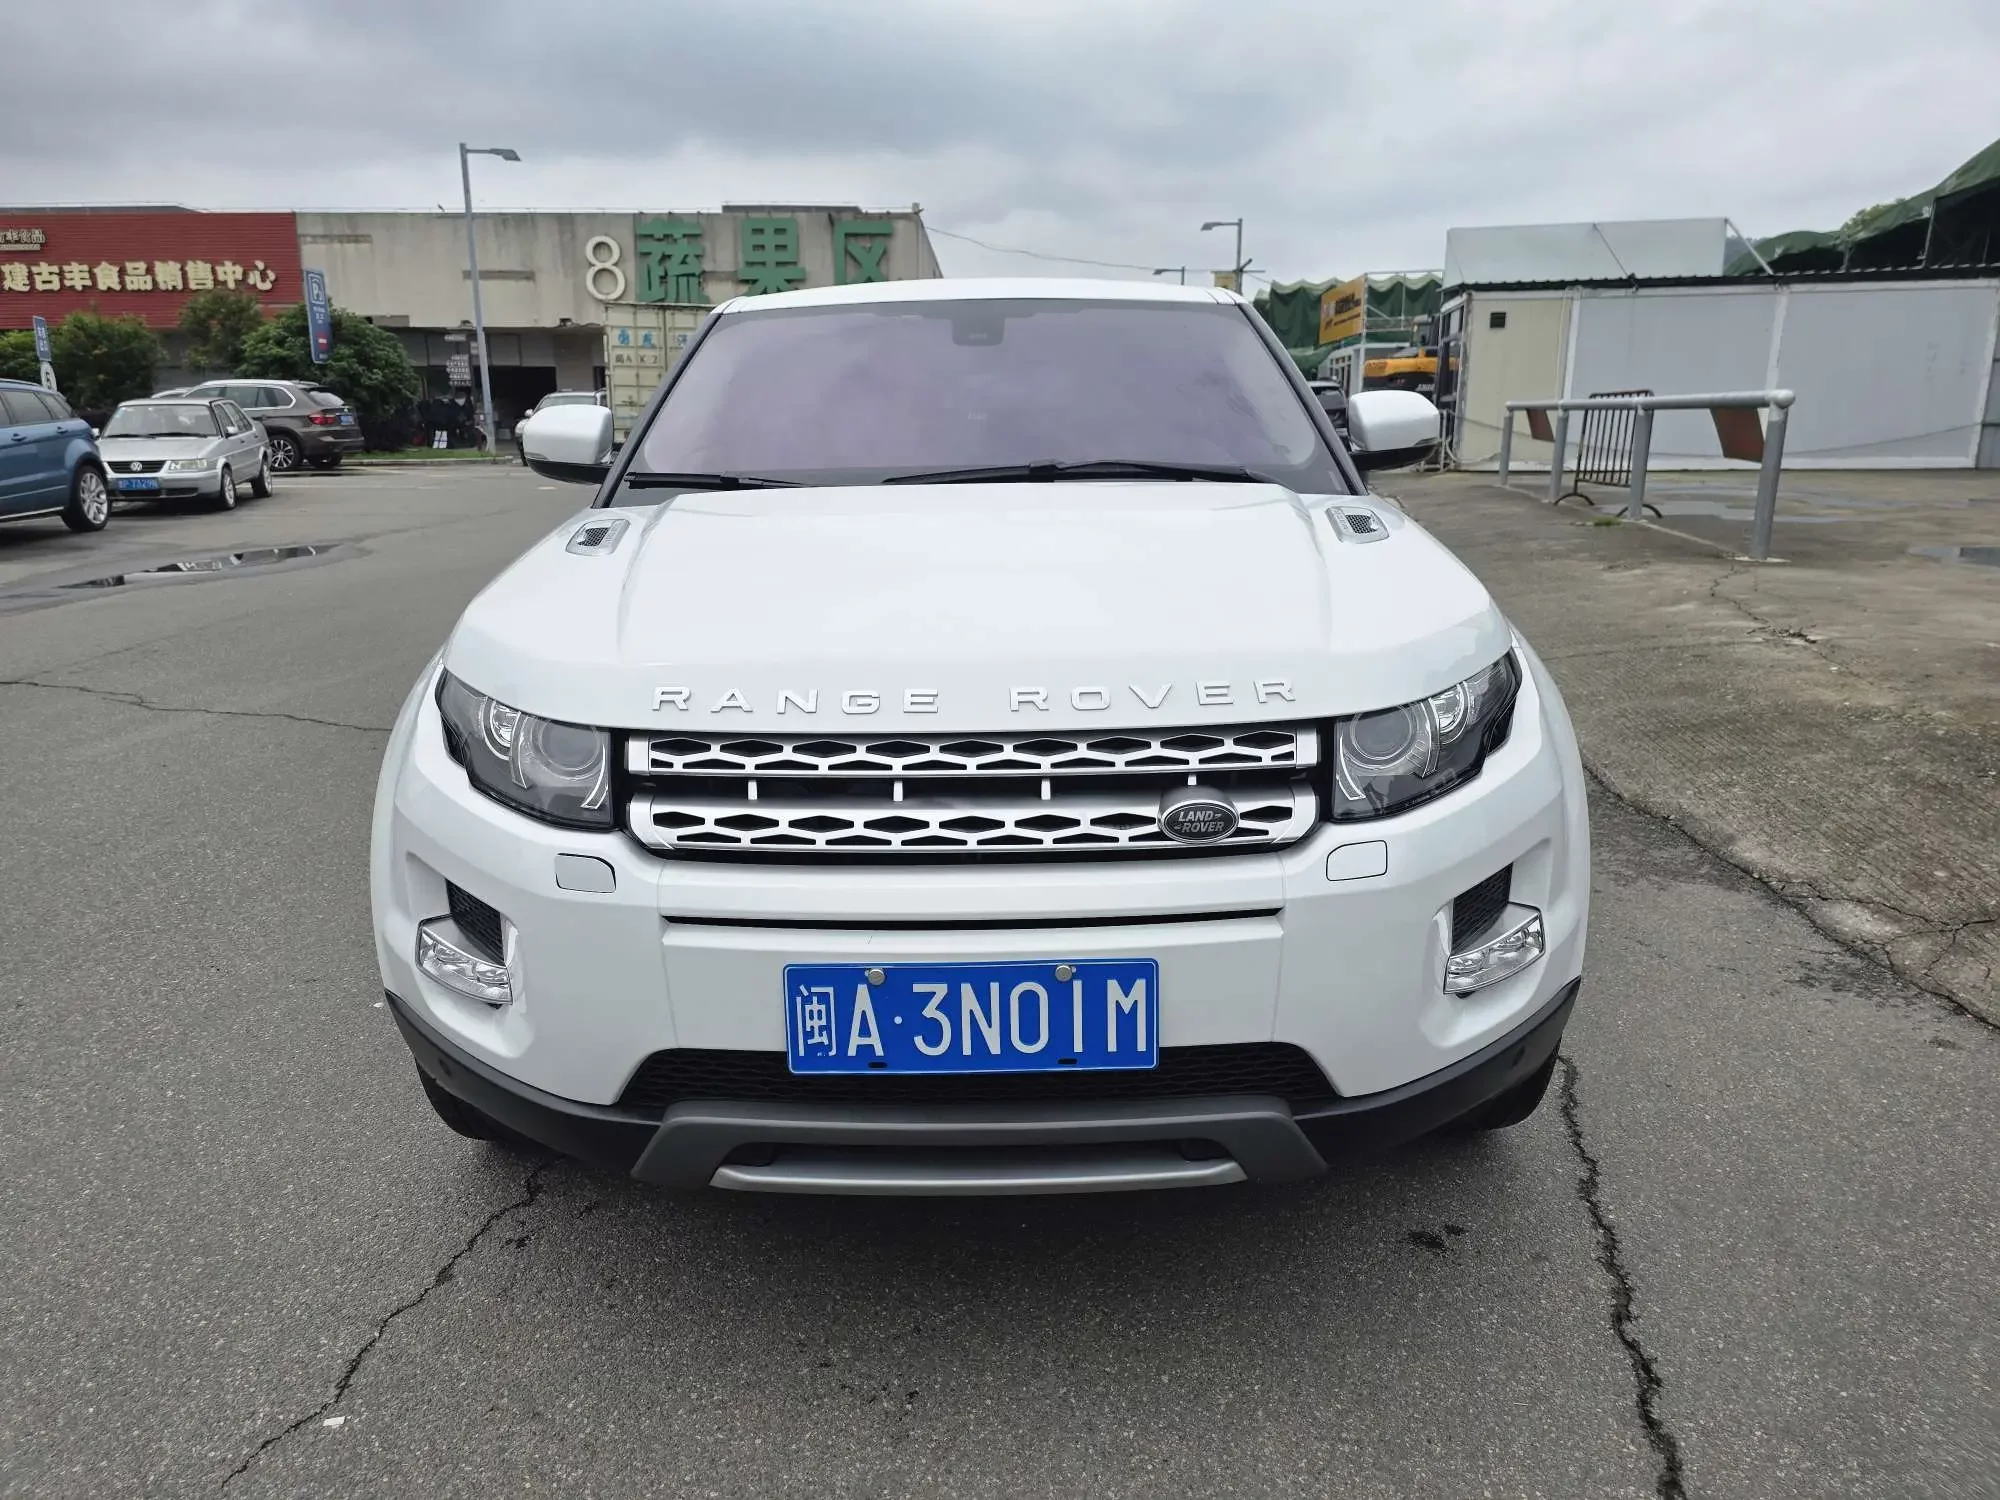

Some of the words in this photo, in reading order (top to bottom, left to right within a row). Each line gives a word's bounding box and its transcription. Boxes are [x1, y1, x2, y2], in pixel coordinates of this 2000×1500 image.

[1, 260, 276, 292] 建古丰食品销售中心
[585, 236, 626, 302] 8
[635, 217, 894, 304] 蔬果区
[652, 685, 940, 714] RANGE
[1009, 679, 1297, 712] ROVER
[1178, 811, 1214, 822] LAND
[1181, 821, 1225, 833] ROVER
